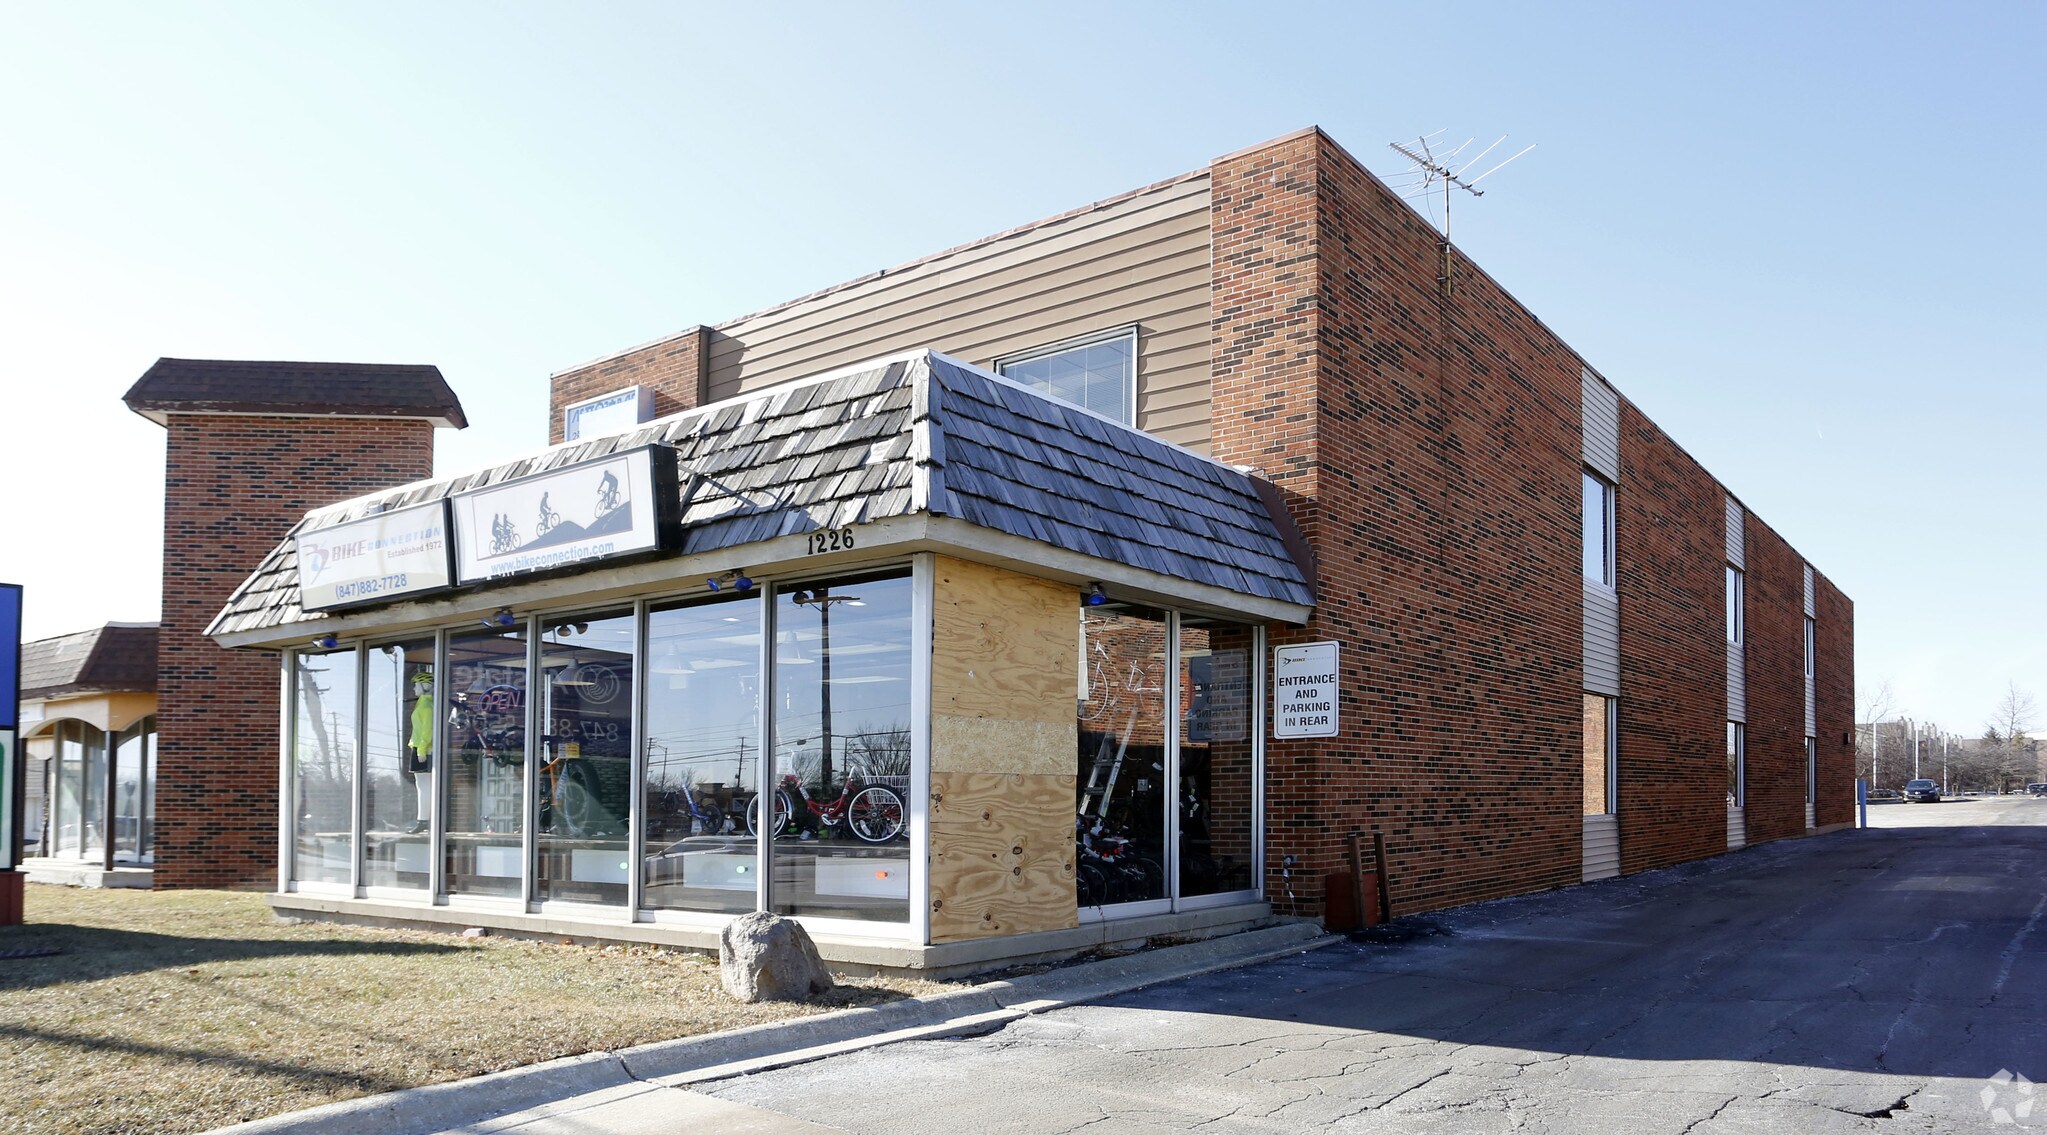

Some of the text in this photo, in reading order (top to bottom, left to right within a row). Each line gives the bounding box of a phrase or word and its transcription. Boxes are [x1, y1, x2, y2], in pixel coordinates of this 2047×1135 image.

[332, 527, 441, 562] BIKE CONNECTION
[388, 540, 442, 559] Established 1972
[808, 528, 854, 555] 1226
[490, 542, 615, 574] www.bikeconnection.com
[335, 574, 407, 600] (847)882-7728
[1279, 673, 1335, 687] ENTRANCE
[481, 690, 521, 712] OPEN
[1295, 689, 1318, 699] AND
[1283, 702, 1331, 713] PARKING
[1285, 716, 1328, 727] IN REAR
